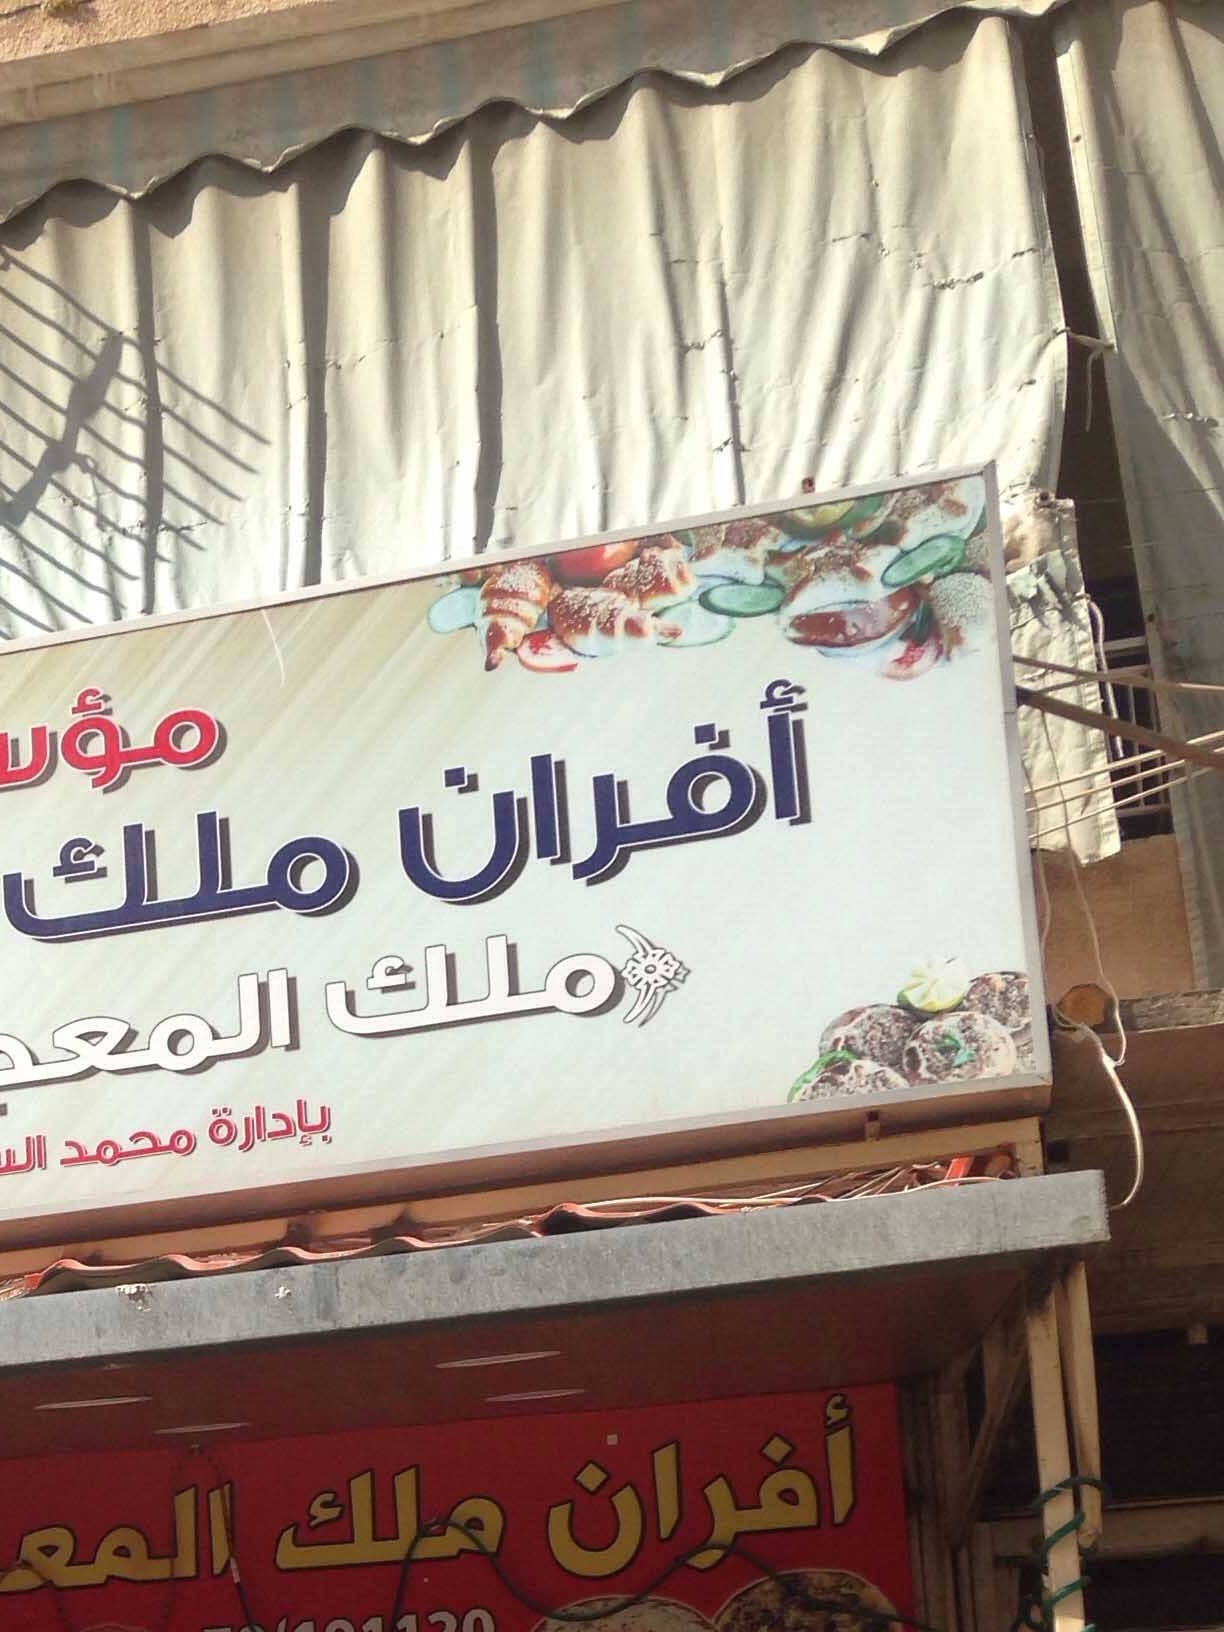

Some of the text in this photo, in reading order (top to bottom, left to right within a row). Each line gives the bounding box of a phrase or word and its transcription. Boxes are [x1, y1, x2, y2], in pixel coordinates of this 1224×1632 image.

[398, 680, 809, 901] أفران
[2, 811, 352, 940] ملك
[326, 935, 619, 1038] ملك
[60, 1128, 196, 1165] محمد
[208, 1099, 331, 1147] بإدارة
[274, 1464, 507, 1571] ملك
[548, 1394, 855, 1577] أفران
